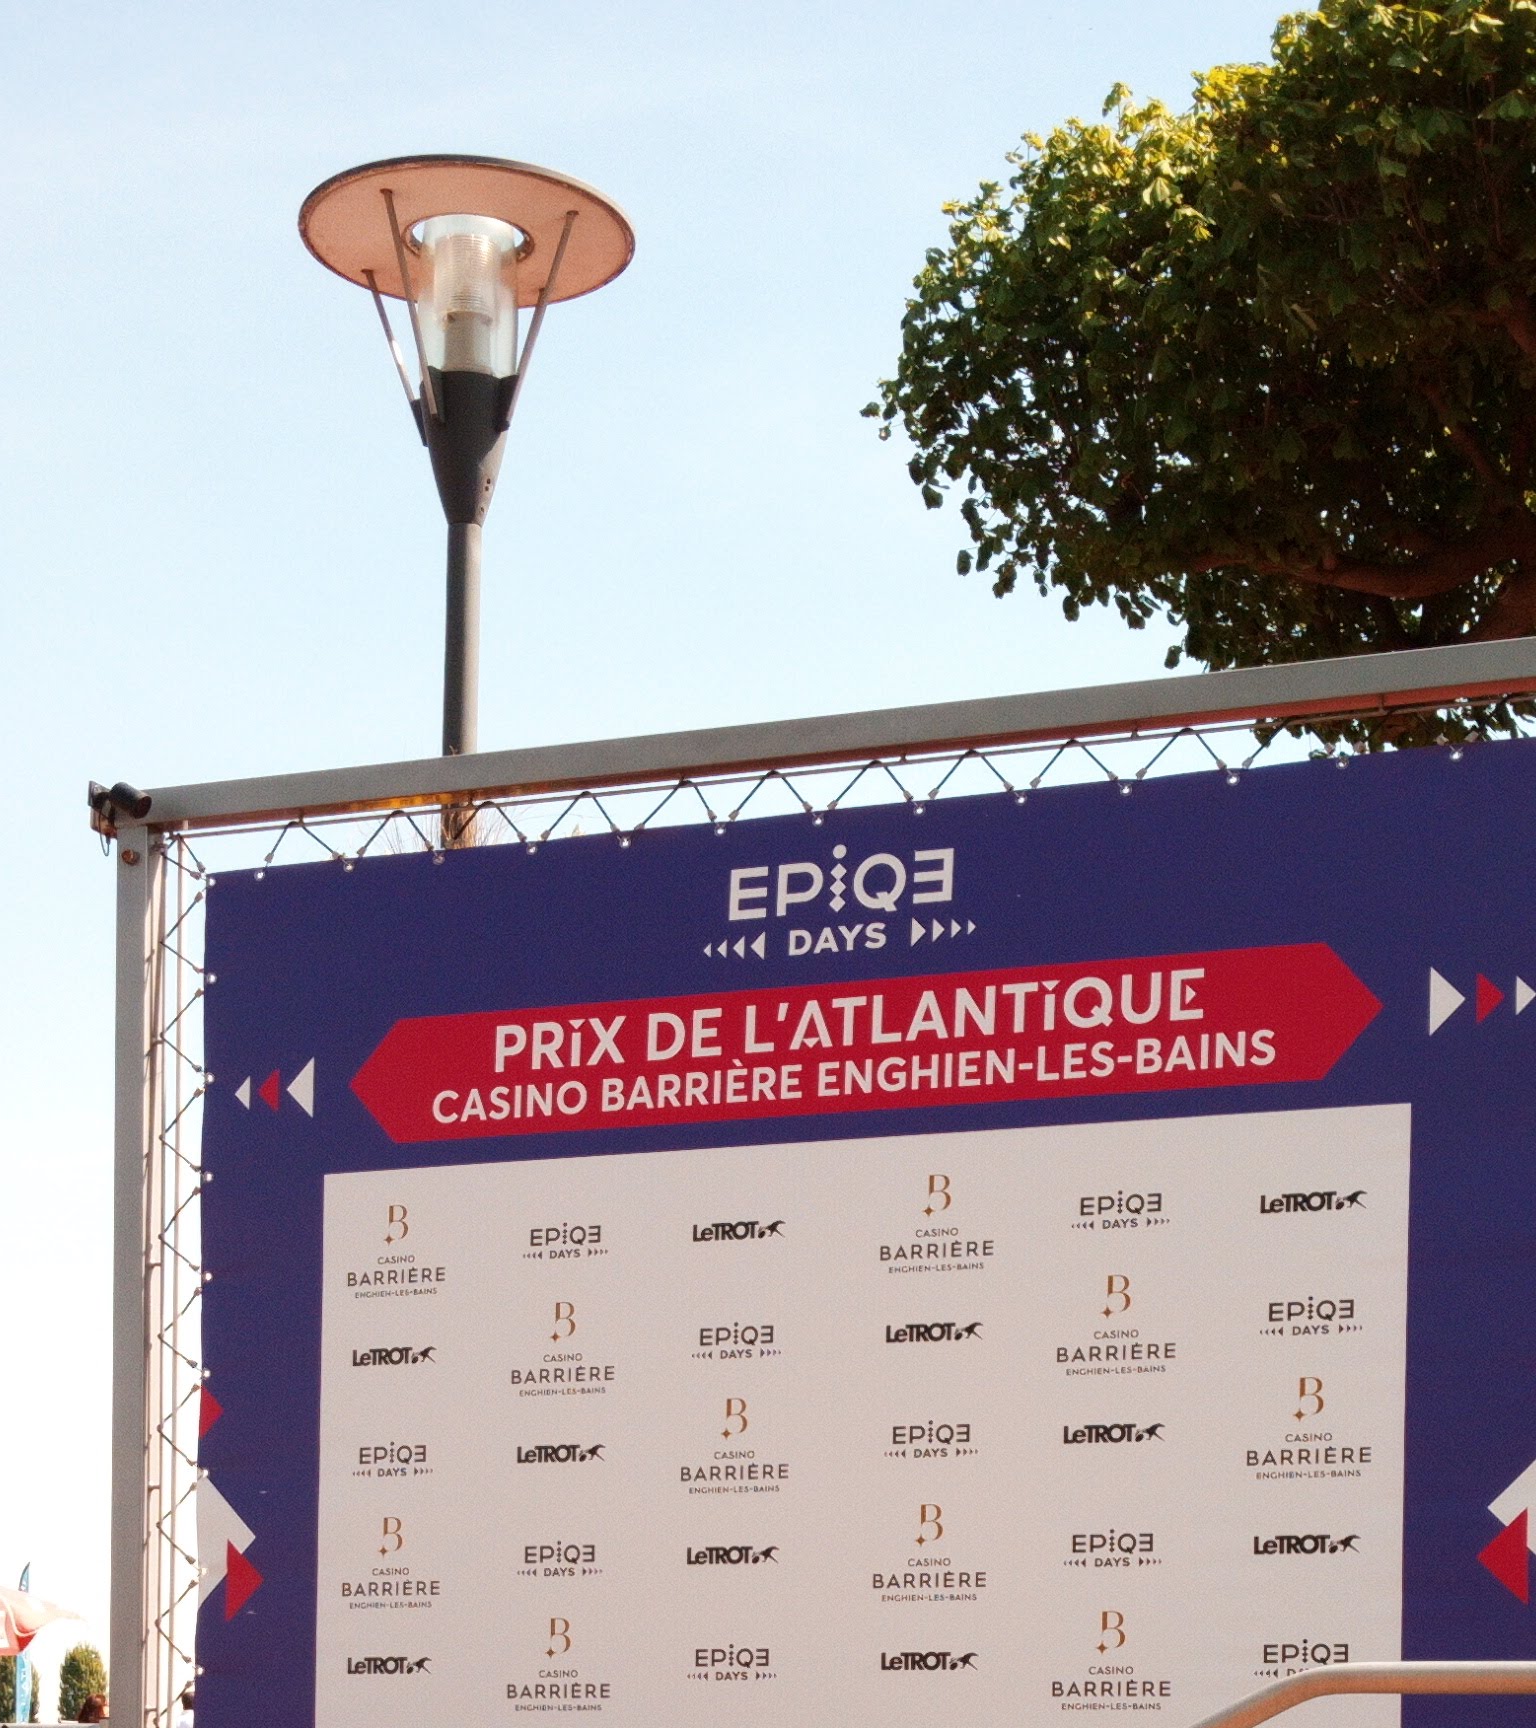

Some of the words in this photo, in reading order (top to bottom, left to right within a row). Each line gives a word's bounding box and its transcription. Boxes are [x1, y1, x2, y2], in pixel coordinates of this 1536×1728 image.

[788, 922, 887, 956] DAYS
[647, 1007, 723, 1062] DE
[432, 1080, 587, 1124] CASINO
[601, 1058, 803, 1113] BARRIÈRE
[817, 1029, 1276, 1097] ENGHIEN-LES-BAINS
[1259, 1190, 1336, 1215] LeTROT
[1101, 1217, 1139, 1231] DAYS
[691, 1220, 758, 1243] LeTROT
[915, 1227, 960, 1238] CASINO
[548, 1247, 582, 1260] DAYS
[879, 1239, 995, 1261] BARRIÈRE
[377, 1254, 416, 1265] CASINO
[888, 1262, 986, 1274] ENGHIEN-LES-BAINS
[346, 1266, 446, 1288] BARRIÈRE
[354, 1287, 438, 1299] ENGHIEN-LES-BAINS
[884, 1322, 955, 1344] LeTROT
[1093, 1329, 1141, 1340] CASINO
[1291, 1323, 1331, 1337] DAYS
[351, 1345, 412, 1367] LeTROT
[543, 1352, 584, 1363] CASINO
[719, 1348, 753, 1360] DAYS
[1055, 1341, 1177, 1363] BARRIÈRE
[510, 1365, 615, 1386] BARRIÈRE
[1065, 1365, 1167, 1377] ENGHIEN-LES-BAINS
[518, 1386, 607, 1397] ENGHIEN-LES-BAINS
[1062, 1423, 1136, 1445] LeTROT
[1284, 1432, 1334, 1443] CASINO
[515, 1443, 579, 1465] LeTROT
[713, 1450, 756, 1460] CASINO
[912, 1447, 949, 1459] DAYS
[1245, 1445, 1372, 1467] BARRIÈRE
[376, 1466, 408, 1478] DAYS
[679, 1462, 789, 1483] BARRIÈRE
[1255, 1469, 1363, 1480] ENGHIEN-LES-BAINS
[688, 1485, 781, 1495] ENGHIEN-LES-BAINS
[1252, 1534, 1329, 1556] LeTROT
[685, 1544, 752, 1566] LeTROT
[907, 1557, 953, 1567] CASINO
[1093, 1556, 1131, 1569] DAYS
[372, 1567, 411, 1576] CASINO
[543, 1566, 576, 1578] DAYS
[871, 1570, 987, 1590] BARRIÈRE
[341, 1579, 440, 1598] BARRIÈRE
[881, 1593, 979, 1602] ENGHIEN-LES-BAINS
[349, 1601, 433, 1610] ENGHIEN-LES-BAINS
[346, 1655, 407, 1676] LeTROT
[879, 1650, 950, 1672] LeTROT
[538, 1669, 580, 1679] CASINO
[714, 1670, 749, 1682] DAYS
[1088, 1665, 1135, 1676] CASINO
[506, 1681, 611, 1700] BARRIÈRE
[1051, 1678, 1172, 1698] BARRIÈRE
[514, 1704, 603, 1712] ENGHIEN-LES-BAINS
[1060, 1702, 1163, 1711] ENGHIEN-LES-BAINS
